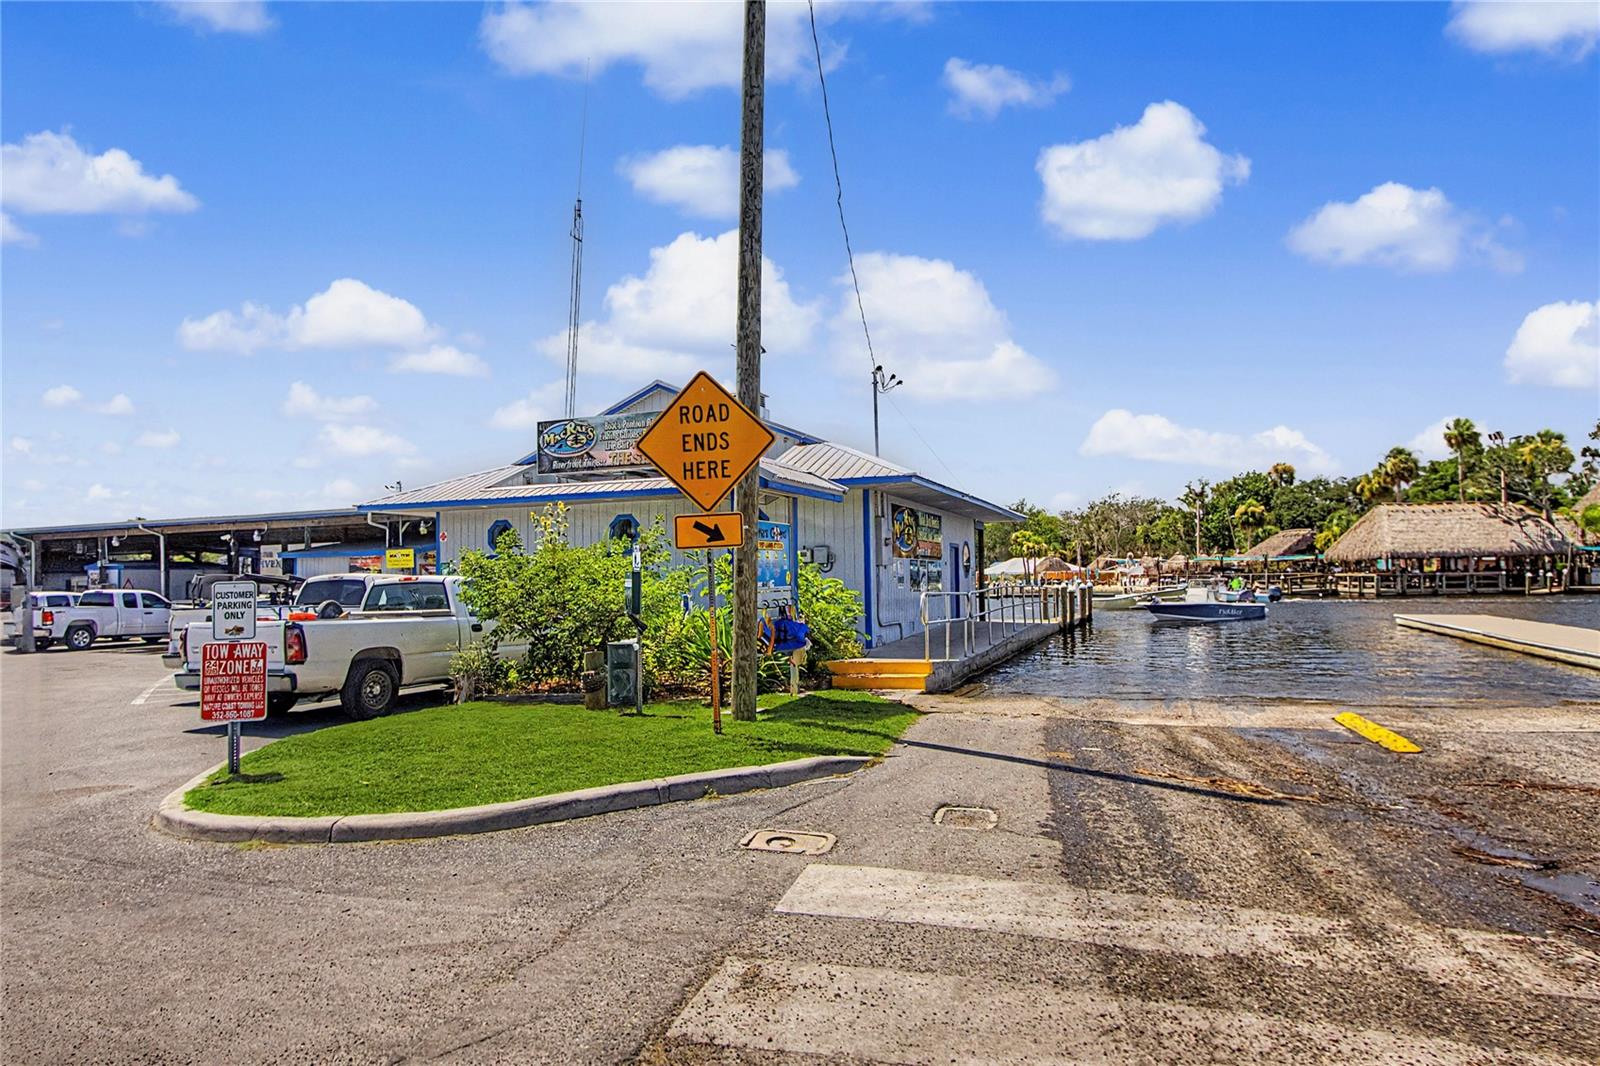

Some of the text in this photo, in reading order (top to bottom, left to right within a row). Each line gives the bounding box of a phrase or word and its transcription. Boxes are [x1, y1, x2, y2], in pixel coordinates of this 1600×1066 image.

[679, 403, 730, 425] ROAD
[681, 432, 730, 452] ENDS
[608, 452, 632, 465] THE
[683, 460, 732, 480] HERE
[215, 591, 254, 600] CUSTOMER
[217, 601, 252, 610] PARKING
[224, 611, 246, 620] ONLY
[206, 644, 265, 660] TOW AWAY
[219, 660, 249, 675] ZONE
[204, 675, 264, 684] UNAUTHORIZED VEHICLES
[222, 702, 237, 710] COAST
